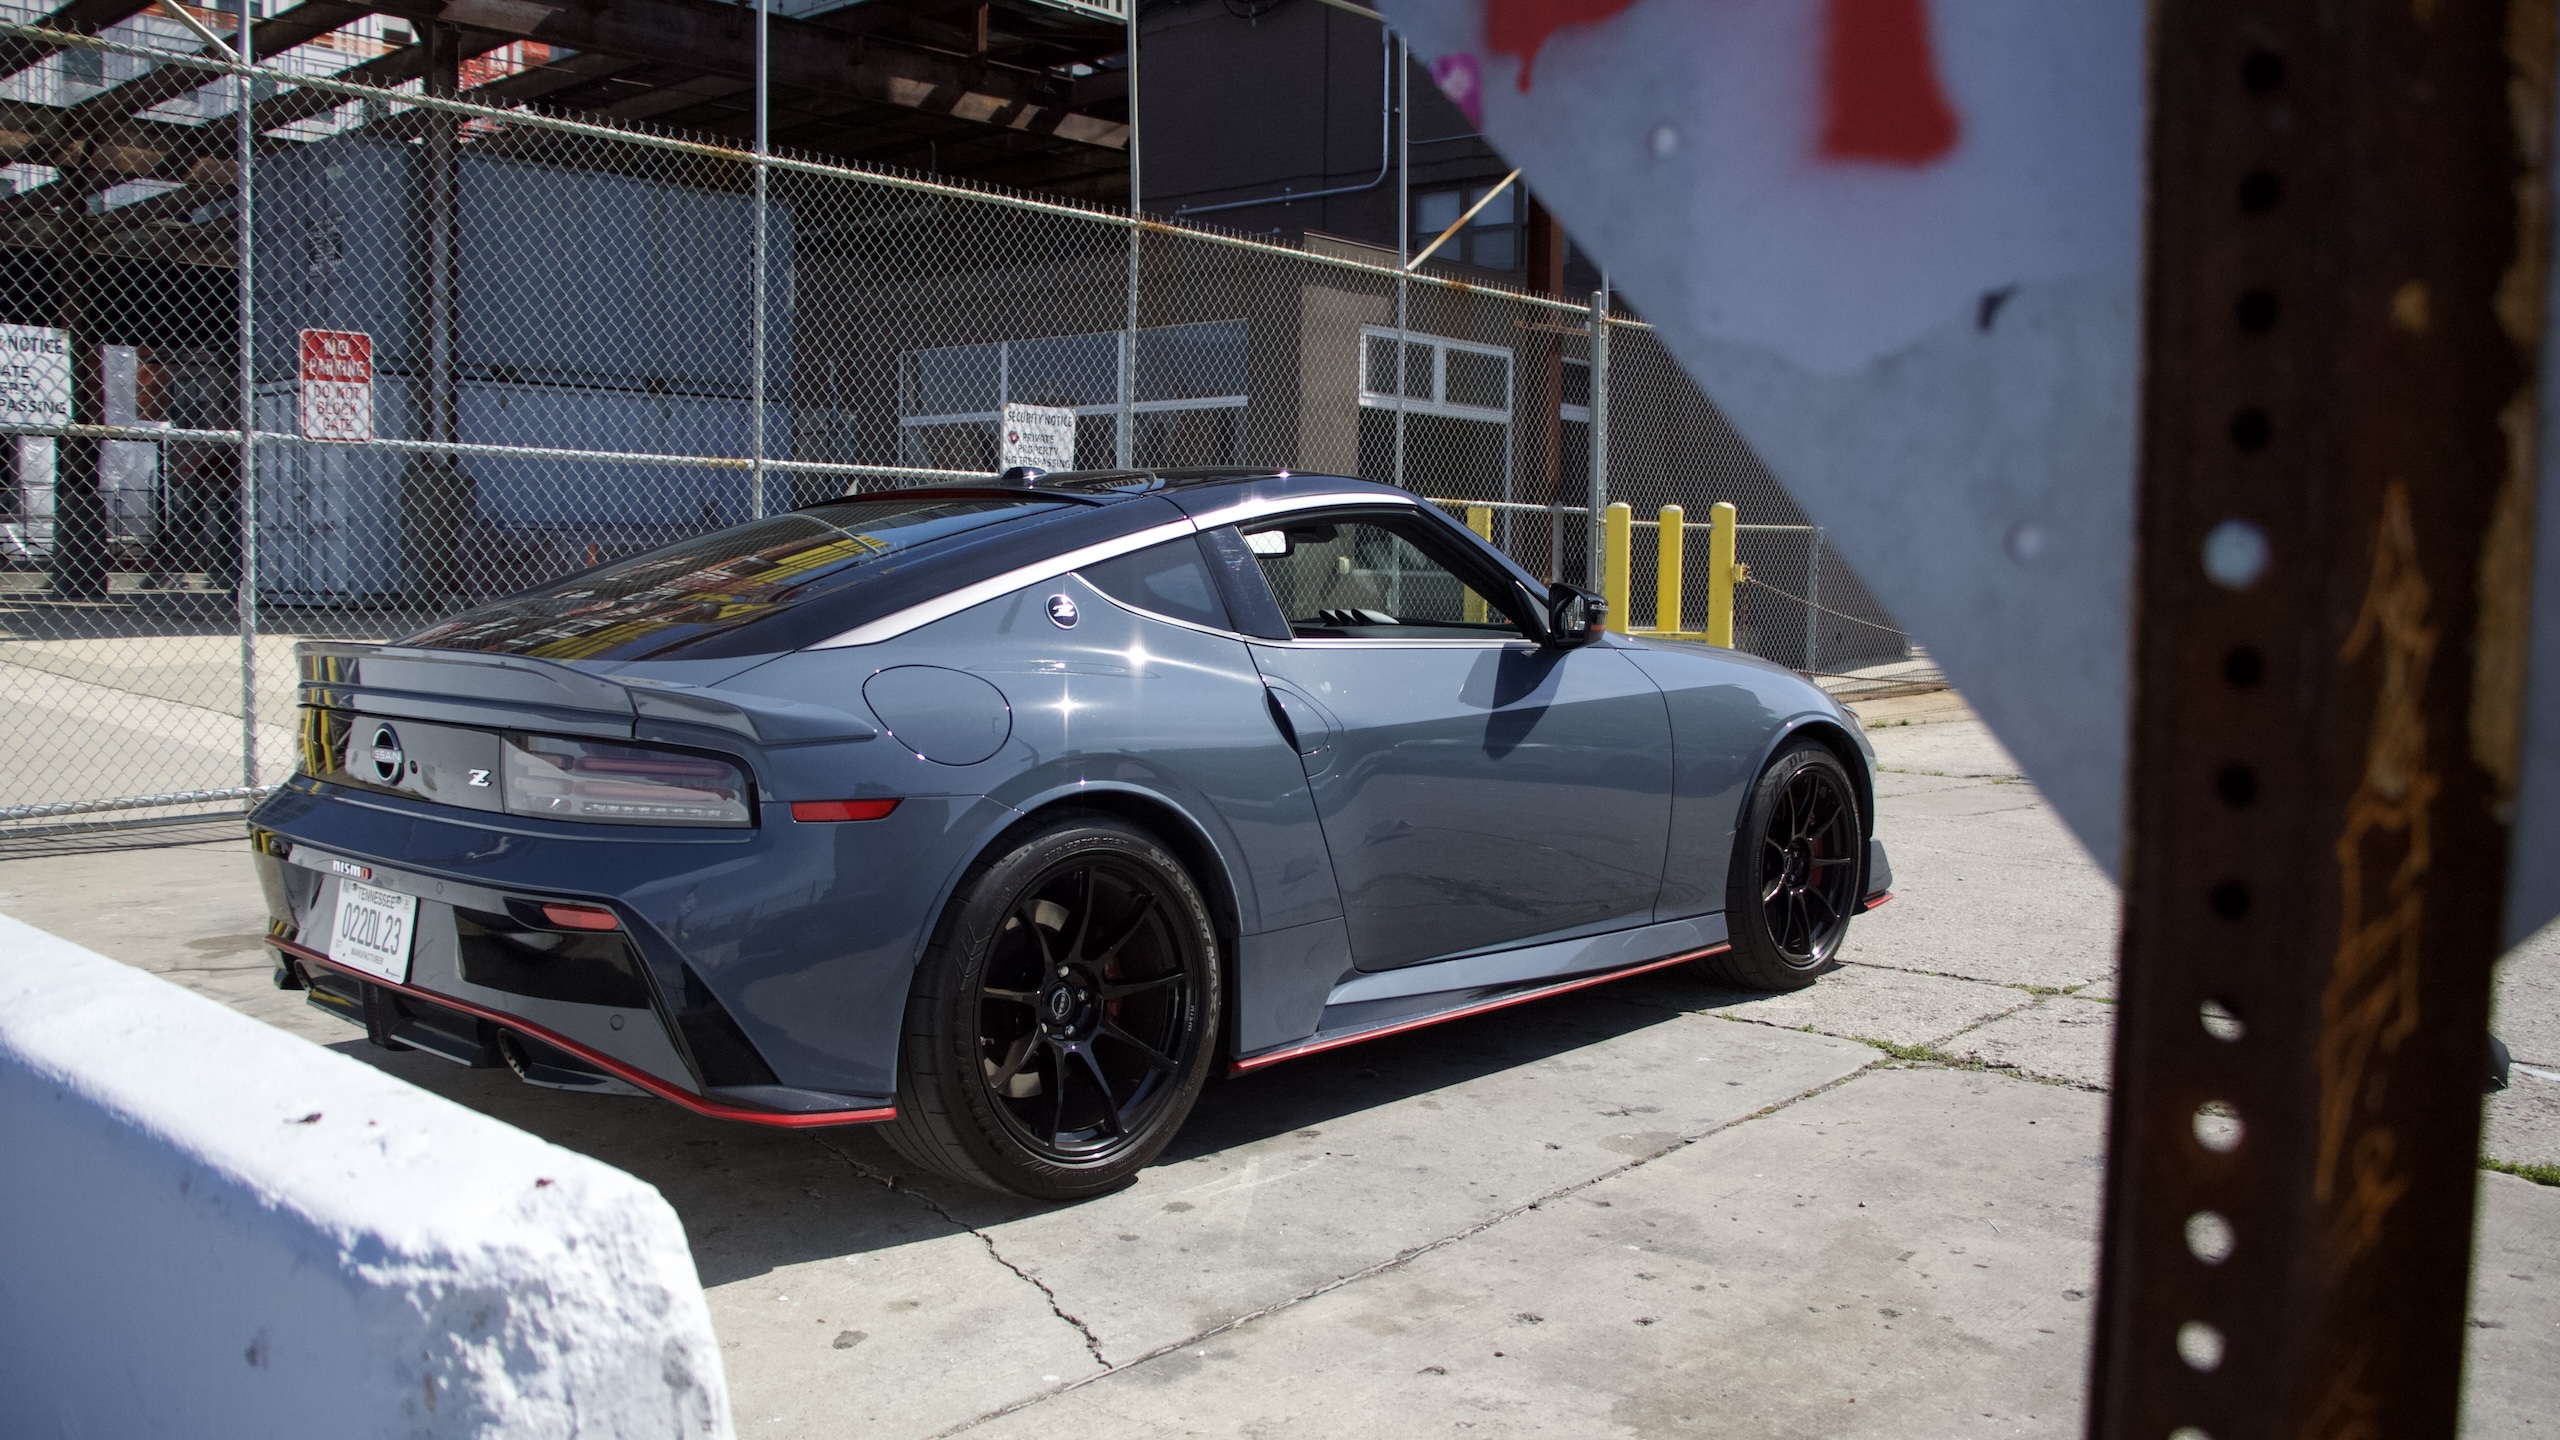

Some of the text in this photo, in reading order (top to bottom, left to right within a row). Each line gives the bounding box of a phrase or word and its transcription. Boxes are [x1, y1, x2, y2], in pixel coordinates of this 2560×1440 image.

[8, 335, 62, 354] NOTICE
[324, 339, 350, 356] NO
[309, 358, 365, 377] PARKING
[313, 385, 360, 399] DO NOT
[317, 401, 357, 415] BLOCK
[323, 418, 353, 432] GATE
[1008, 411, 1073, 427] SECURITY NOTICE
[1022, 432, 1055, 444] PRIVATE
[1018, 445, 1058, 456] PROPERTY
[1005, 455, 1071, 469] NO TRESPASSING
[372, 749, 401, 761] SSAN
[468, 768, 492, 787] Z
[358, 886, 395, 909] TENNESSEE
[342, 902, 402, 955] 022DL23
[351, 947, 384, 965] MANUFACTURER
